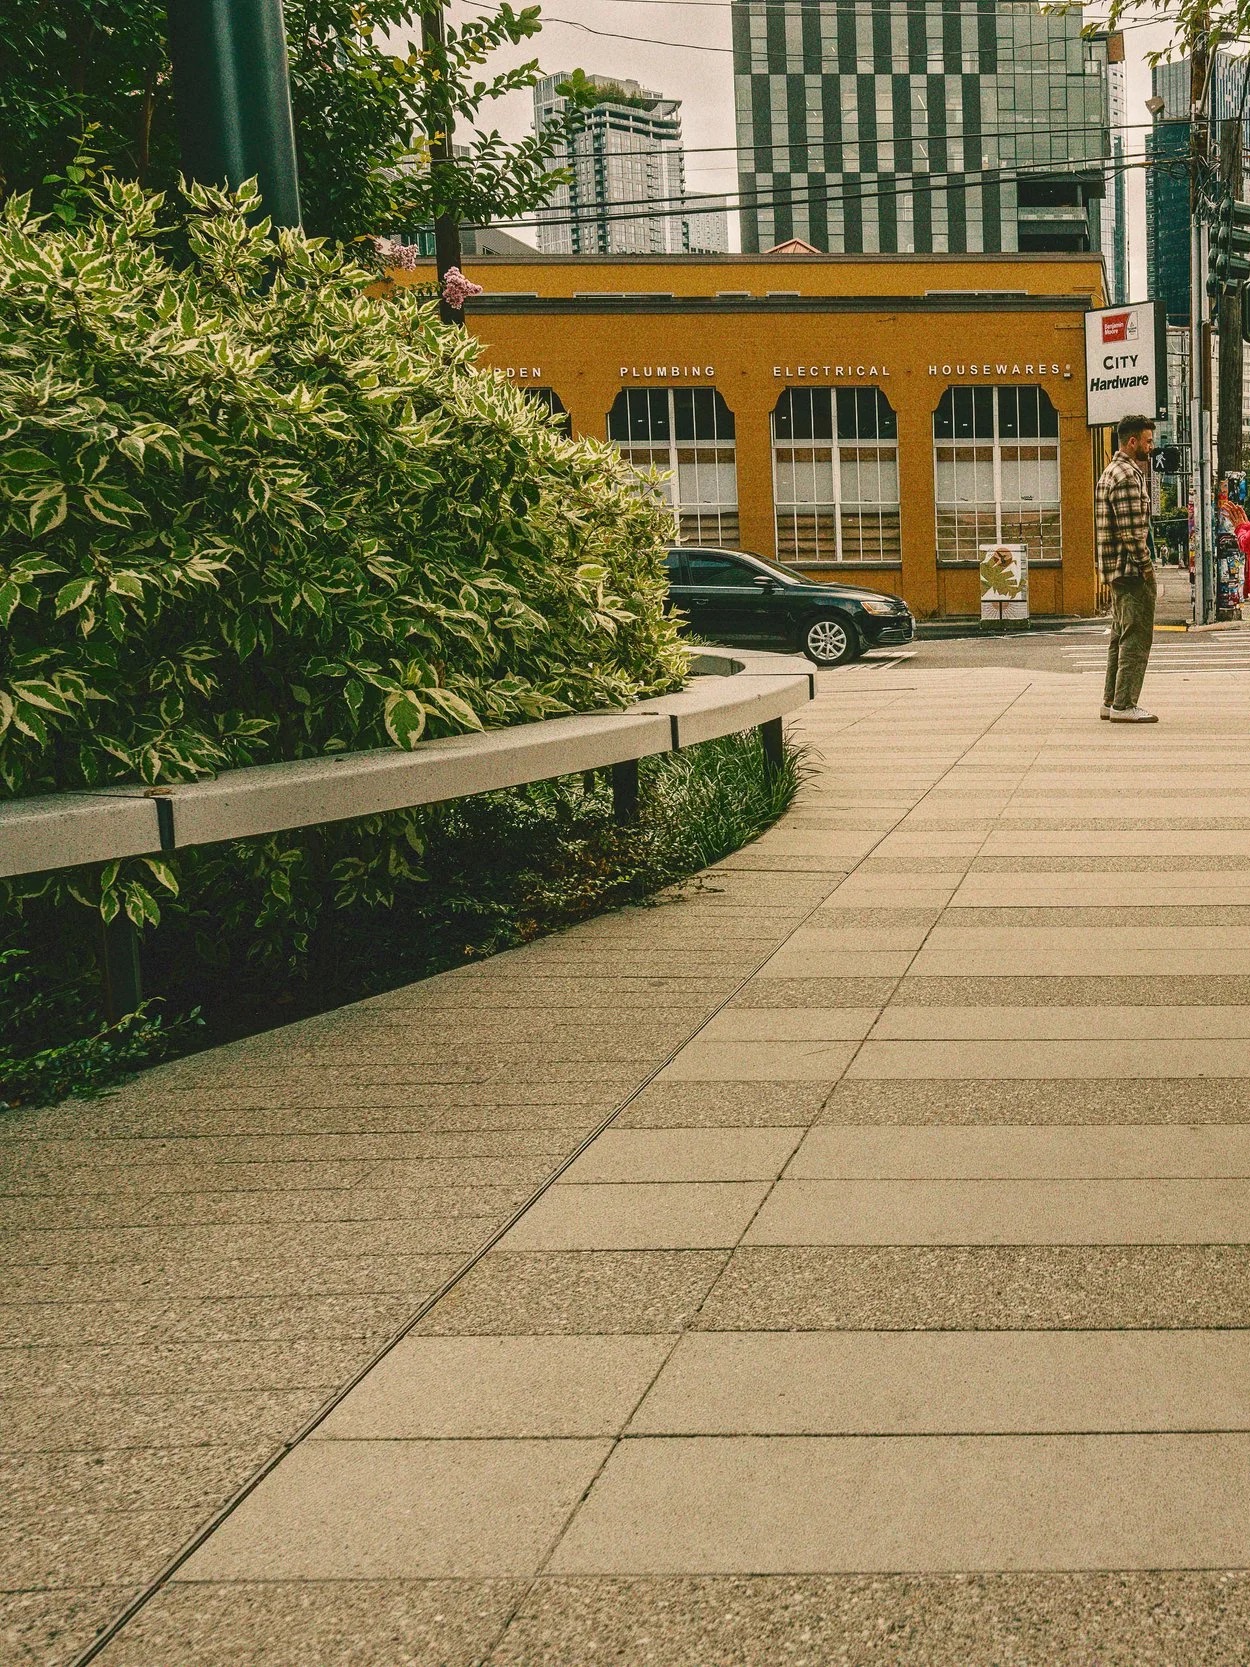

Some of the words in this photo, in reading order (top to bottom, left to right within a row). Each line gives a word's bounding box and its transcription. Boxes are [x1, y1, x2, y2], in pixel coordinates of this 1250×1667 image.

[1104, 321, 1125, 330] Benjamin
[1104, 328, 1119, 336] Moore
[1103, 354, 1139, 371] CITY
[620, 366, 715, 377] PLUMBING
[773, 366, 890, 377] ELECTRICAL
[928, 364, 1060, 376] HOUSEWARES
[1089, 374, 1150, 392] Hardware
